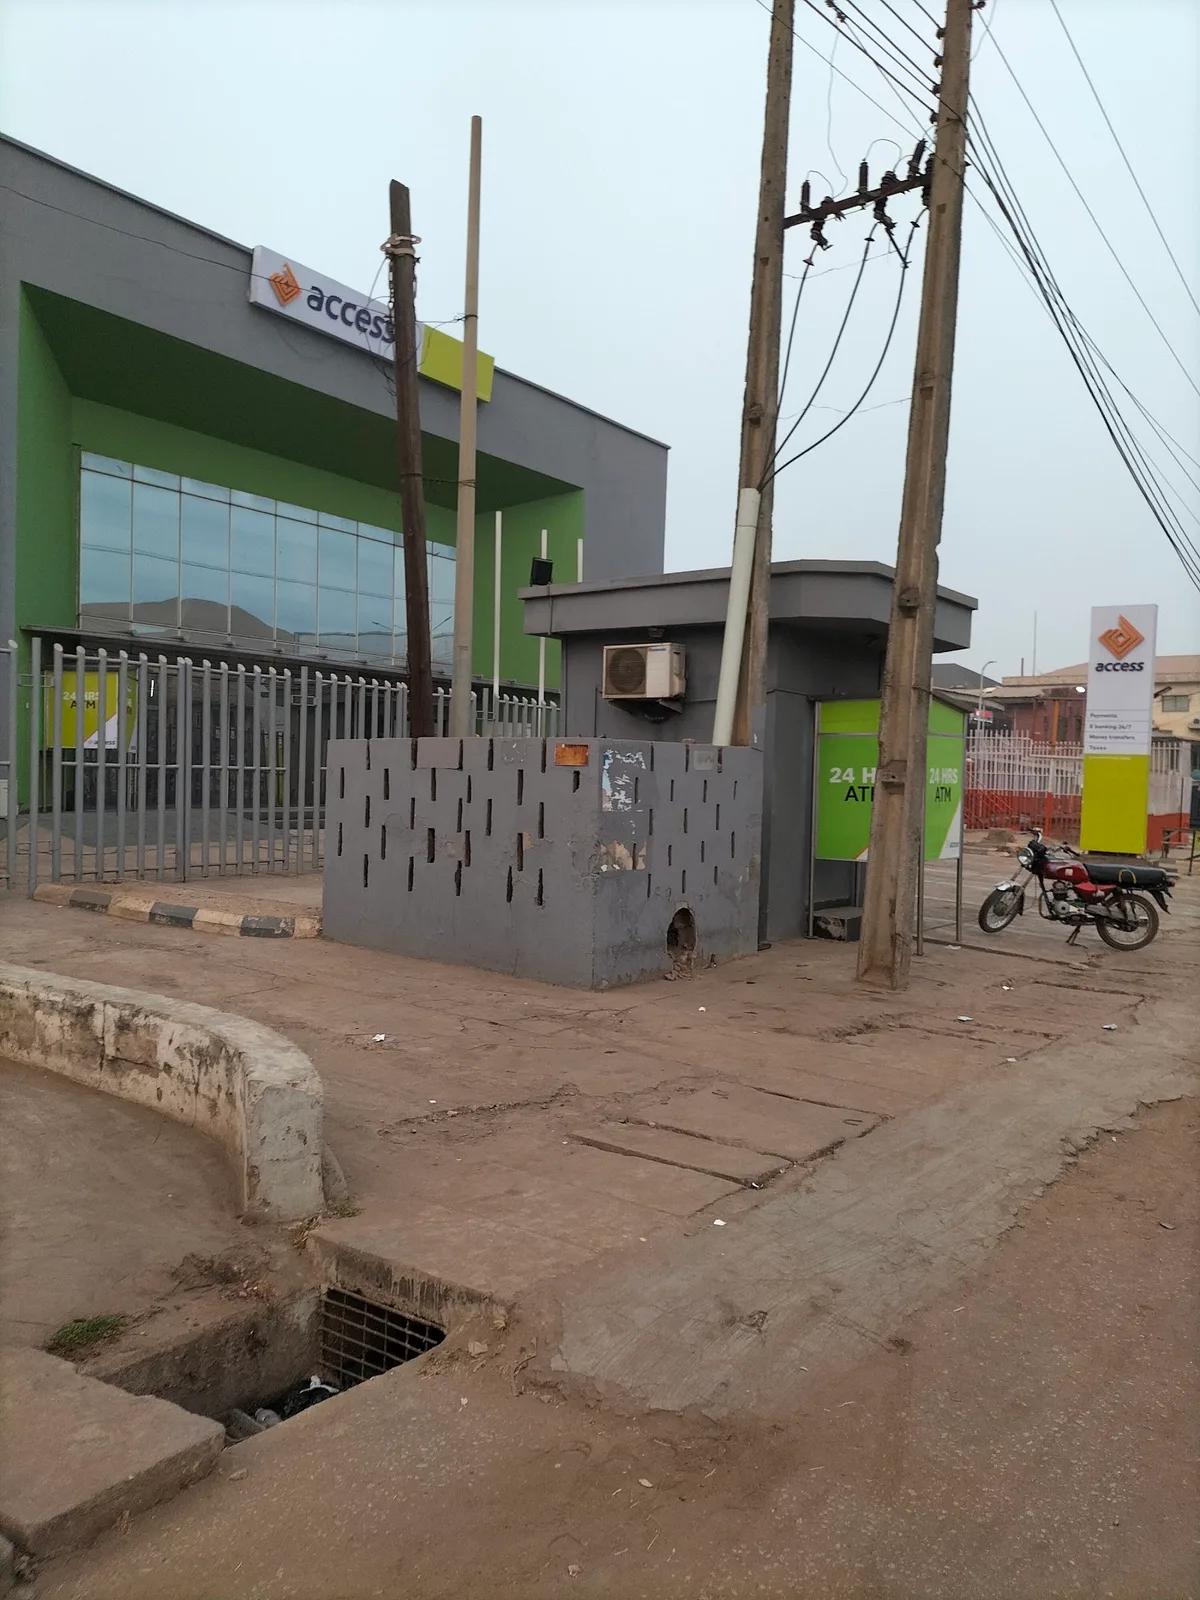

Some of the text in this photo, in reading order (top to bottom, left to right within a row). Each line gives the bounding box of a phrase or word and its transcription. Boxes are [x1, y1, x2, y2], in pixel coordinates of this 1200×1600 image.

[307, 286, 396, 344] access
[1095, 662, 1144, 672] access
[63, 692, 77, 700] 24
[70, 700, 96, 709] AM
[829, 767, 855, 784] 24
[929, 767, 958, 784] 24 HRS
[844, 785, 875, 802] AT
[934, 786, 951, 802] ATM
